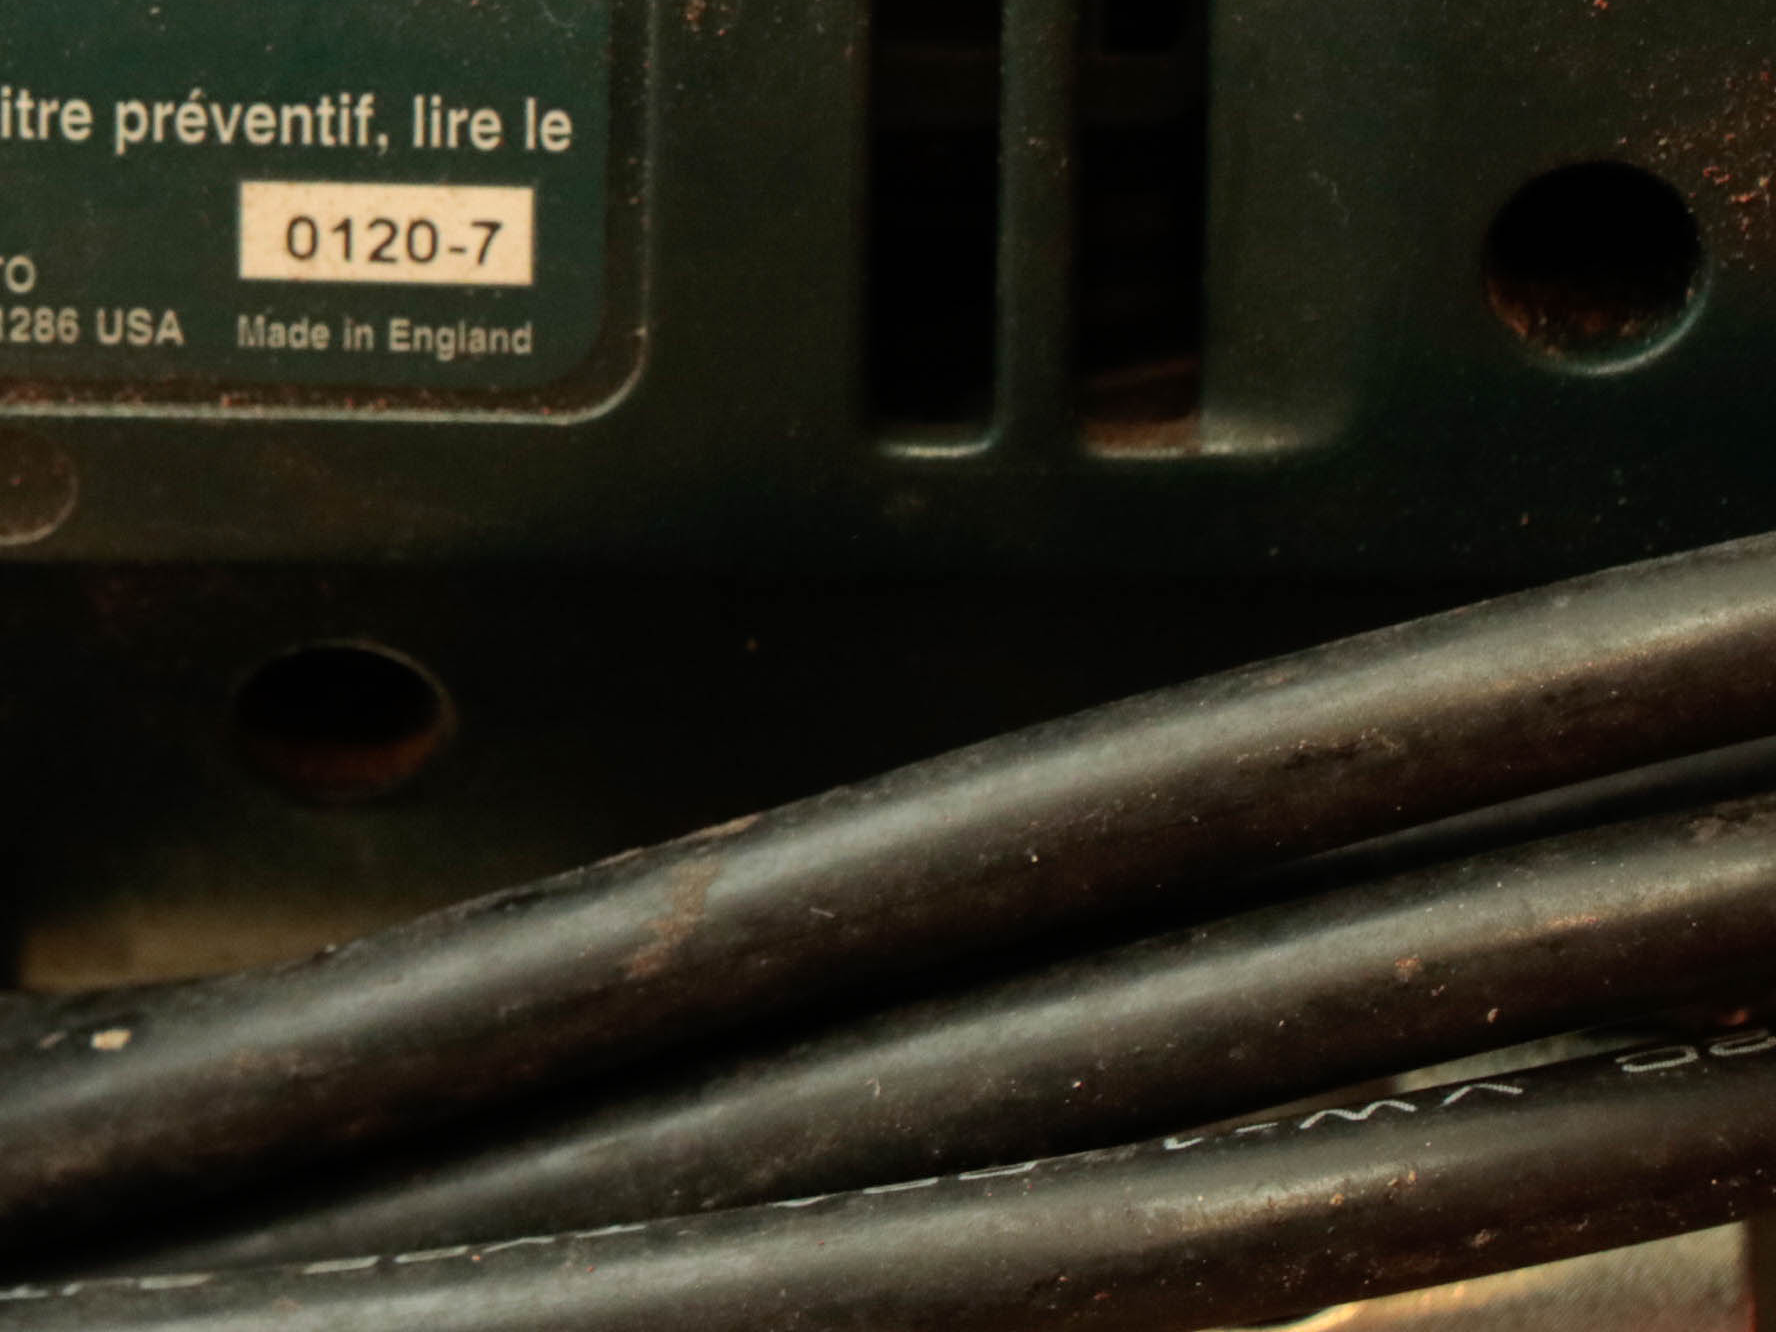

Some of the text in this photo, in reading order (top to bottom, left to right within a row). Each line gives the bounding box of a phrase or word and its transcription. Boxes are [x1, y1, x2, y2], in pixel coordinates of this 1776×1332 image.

[115, 88, 388, 155] préventif,
[412, 94, 502, 151] lire
[525, 97, 572, 152] le
[284, 214, 503, 266] 0120-7
[96, 307, 184, 346] USA
[237, 314, 532, 362] Made in England
